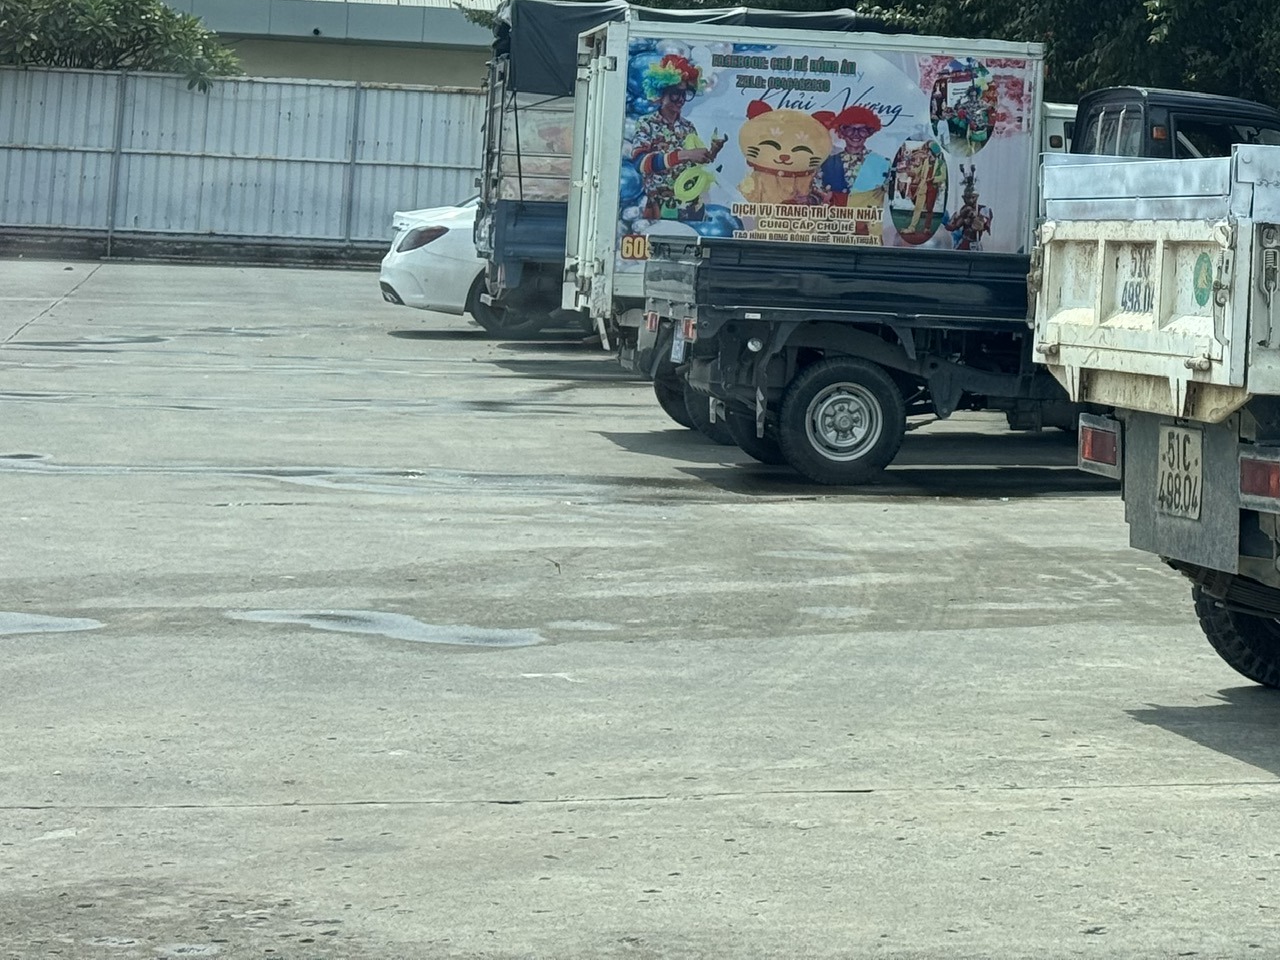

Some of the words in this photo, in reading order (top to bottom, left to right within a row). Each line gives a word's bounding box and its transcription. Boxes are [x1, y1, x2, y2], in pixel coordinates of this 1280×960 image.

[732, 203, 756, 217] DỊCH
[759, 204, 773, 219] VỤ
[775, 205, 808, 218] TRANG
[810, 204, 827, 218] TRÍ
[829, 207, 854, 219] SINH
[856, 205, 883, 223] NHẬT
[759, 220, 789, 229] CUNG
[1167, 431, 1191, 472] 51C
[1158, 470, 1198, 513] 498.04
